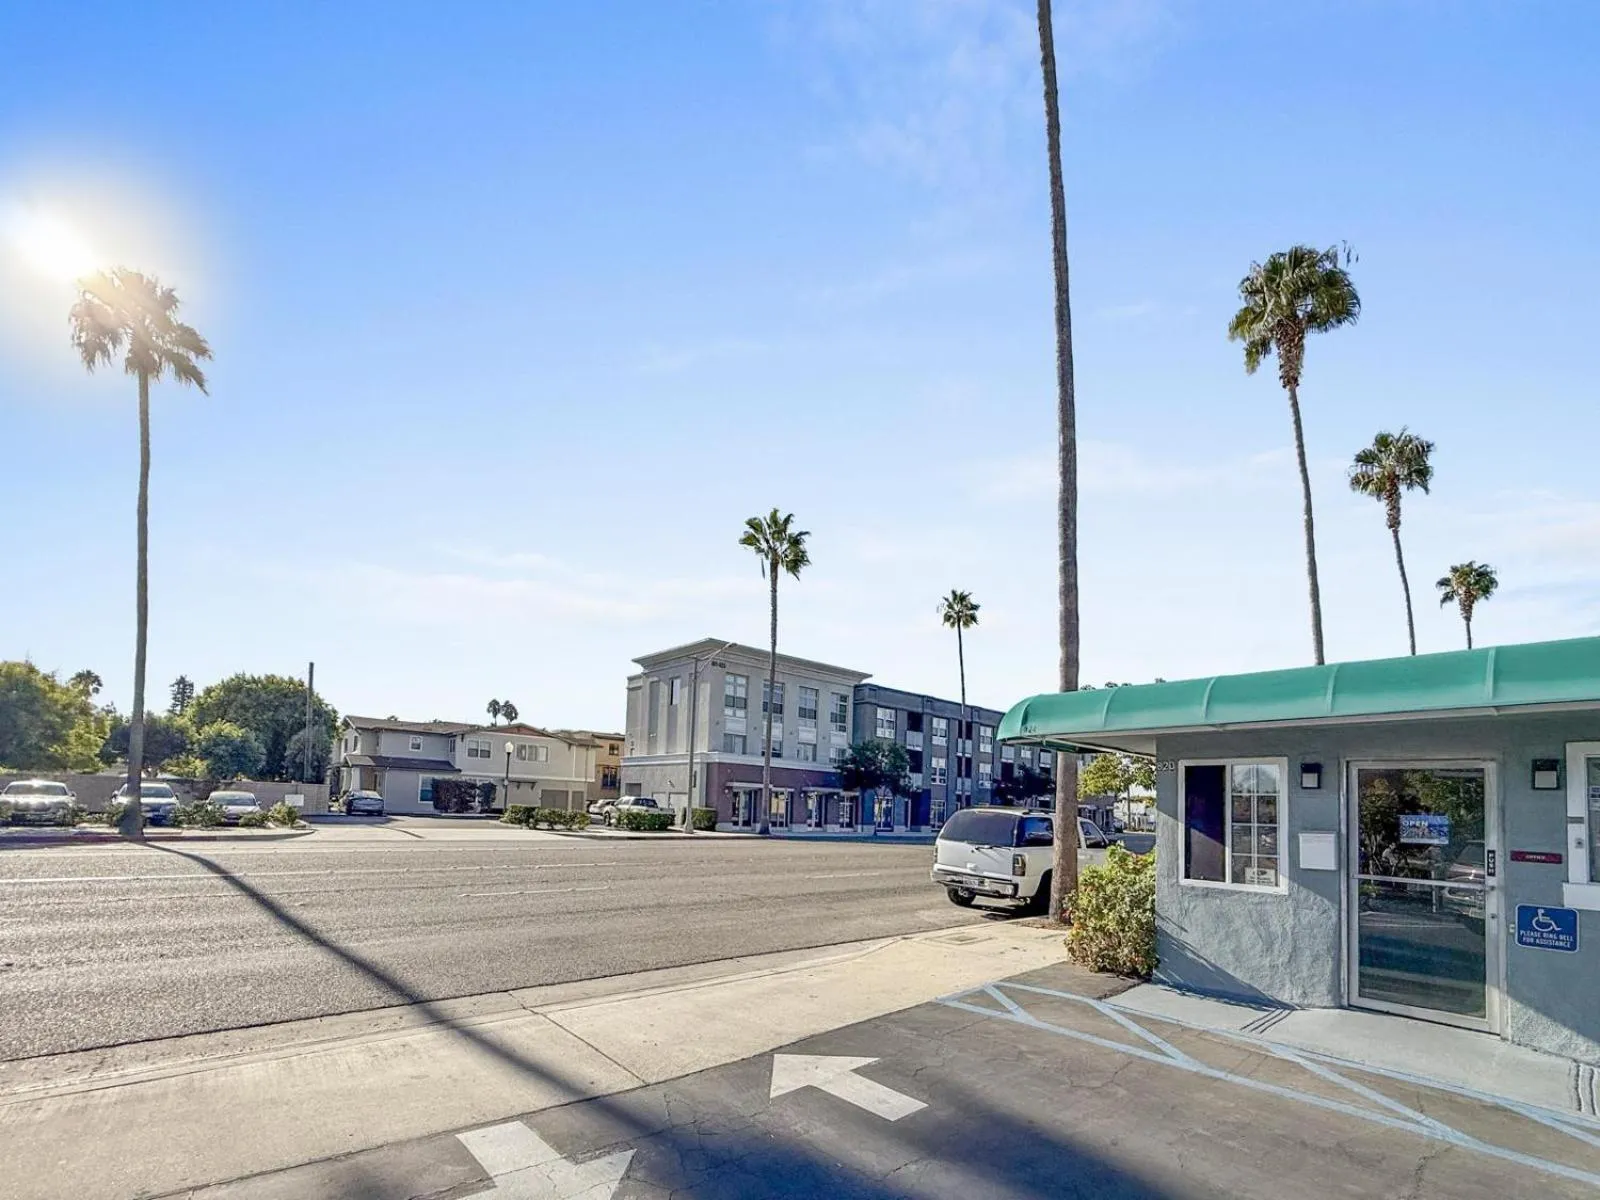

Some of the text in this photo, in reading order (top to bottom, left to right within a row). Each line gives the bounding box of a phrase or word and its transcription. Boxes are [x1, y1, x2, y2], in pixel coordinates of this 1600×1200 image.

[1520, 930, 1541, 938] PLEASE
[1542, 932, 1558, 940] RING
[1535, 938, 1571, 948] ASSISTANCE
